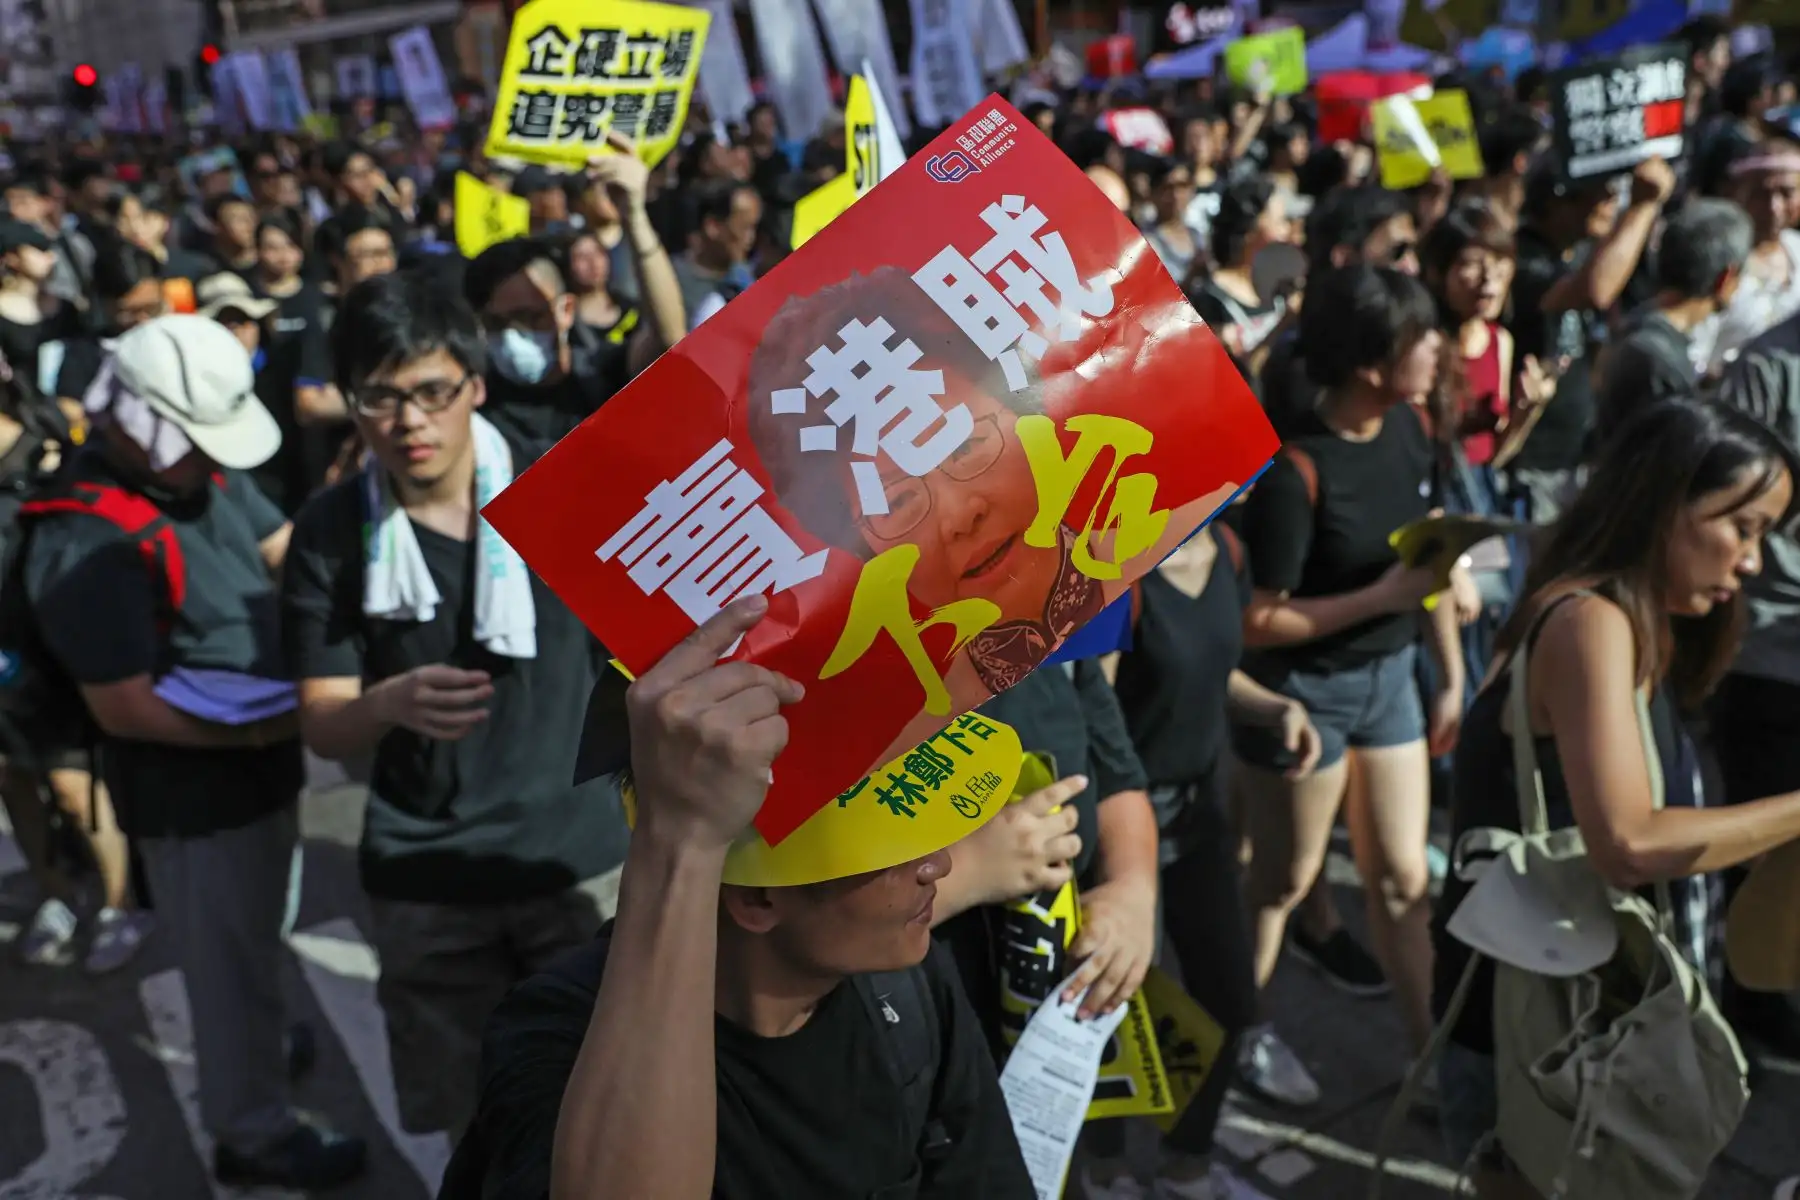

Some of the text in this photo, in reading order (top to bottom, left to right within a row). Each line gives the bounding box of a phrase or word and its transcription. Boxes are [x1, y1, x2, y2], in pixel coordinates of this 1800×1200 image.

[956, 108, 1007, 152] 區政聯盟
[970, 123, 1017, 159] Community
[980, 139, 1015, 168] Alliance
[595, 194, 1114, 658] 賣港賊
[818, 414, 1170, 716] 下台
[837, 714, 998, 819] 林鄭下台
[965, 771, 1002, 799] 民協
